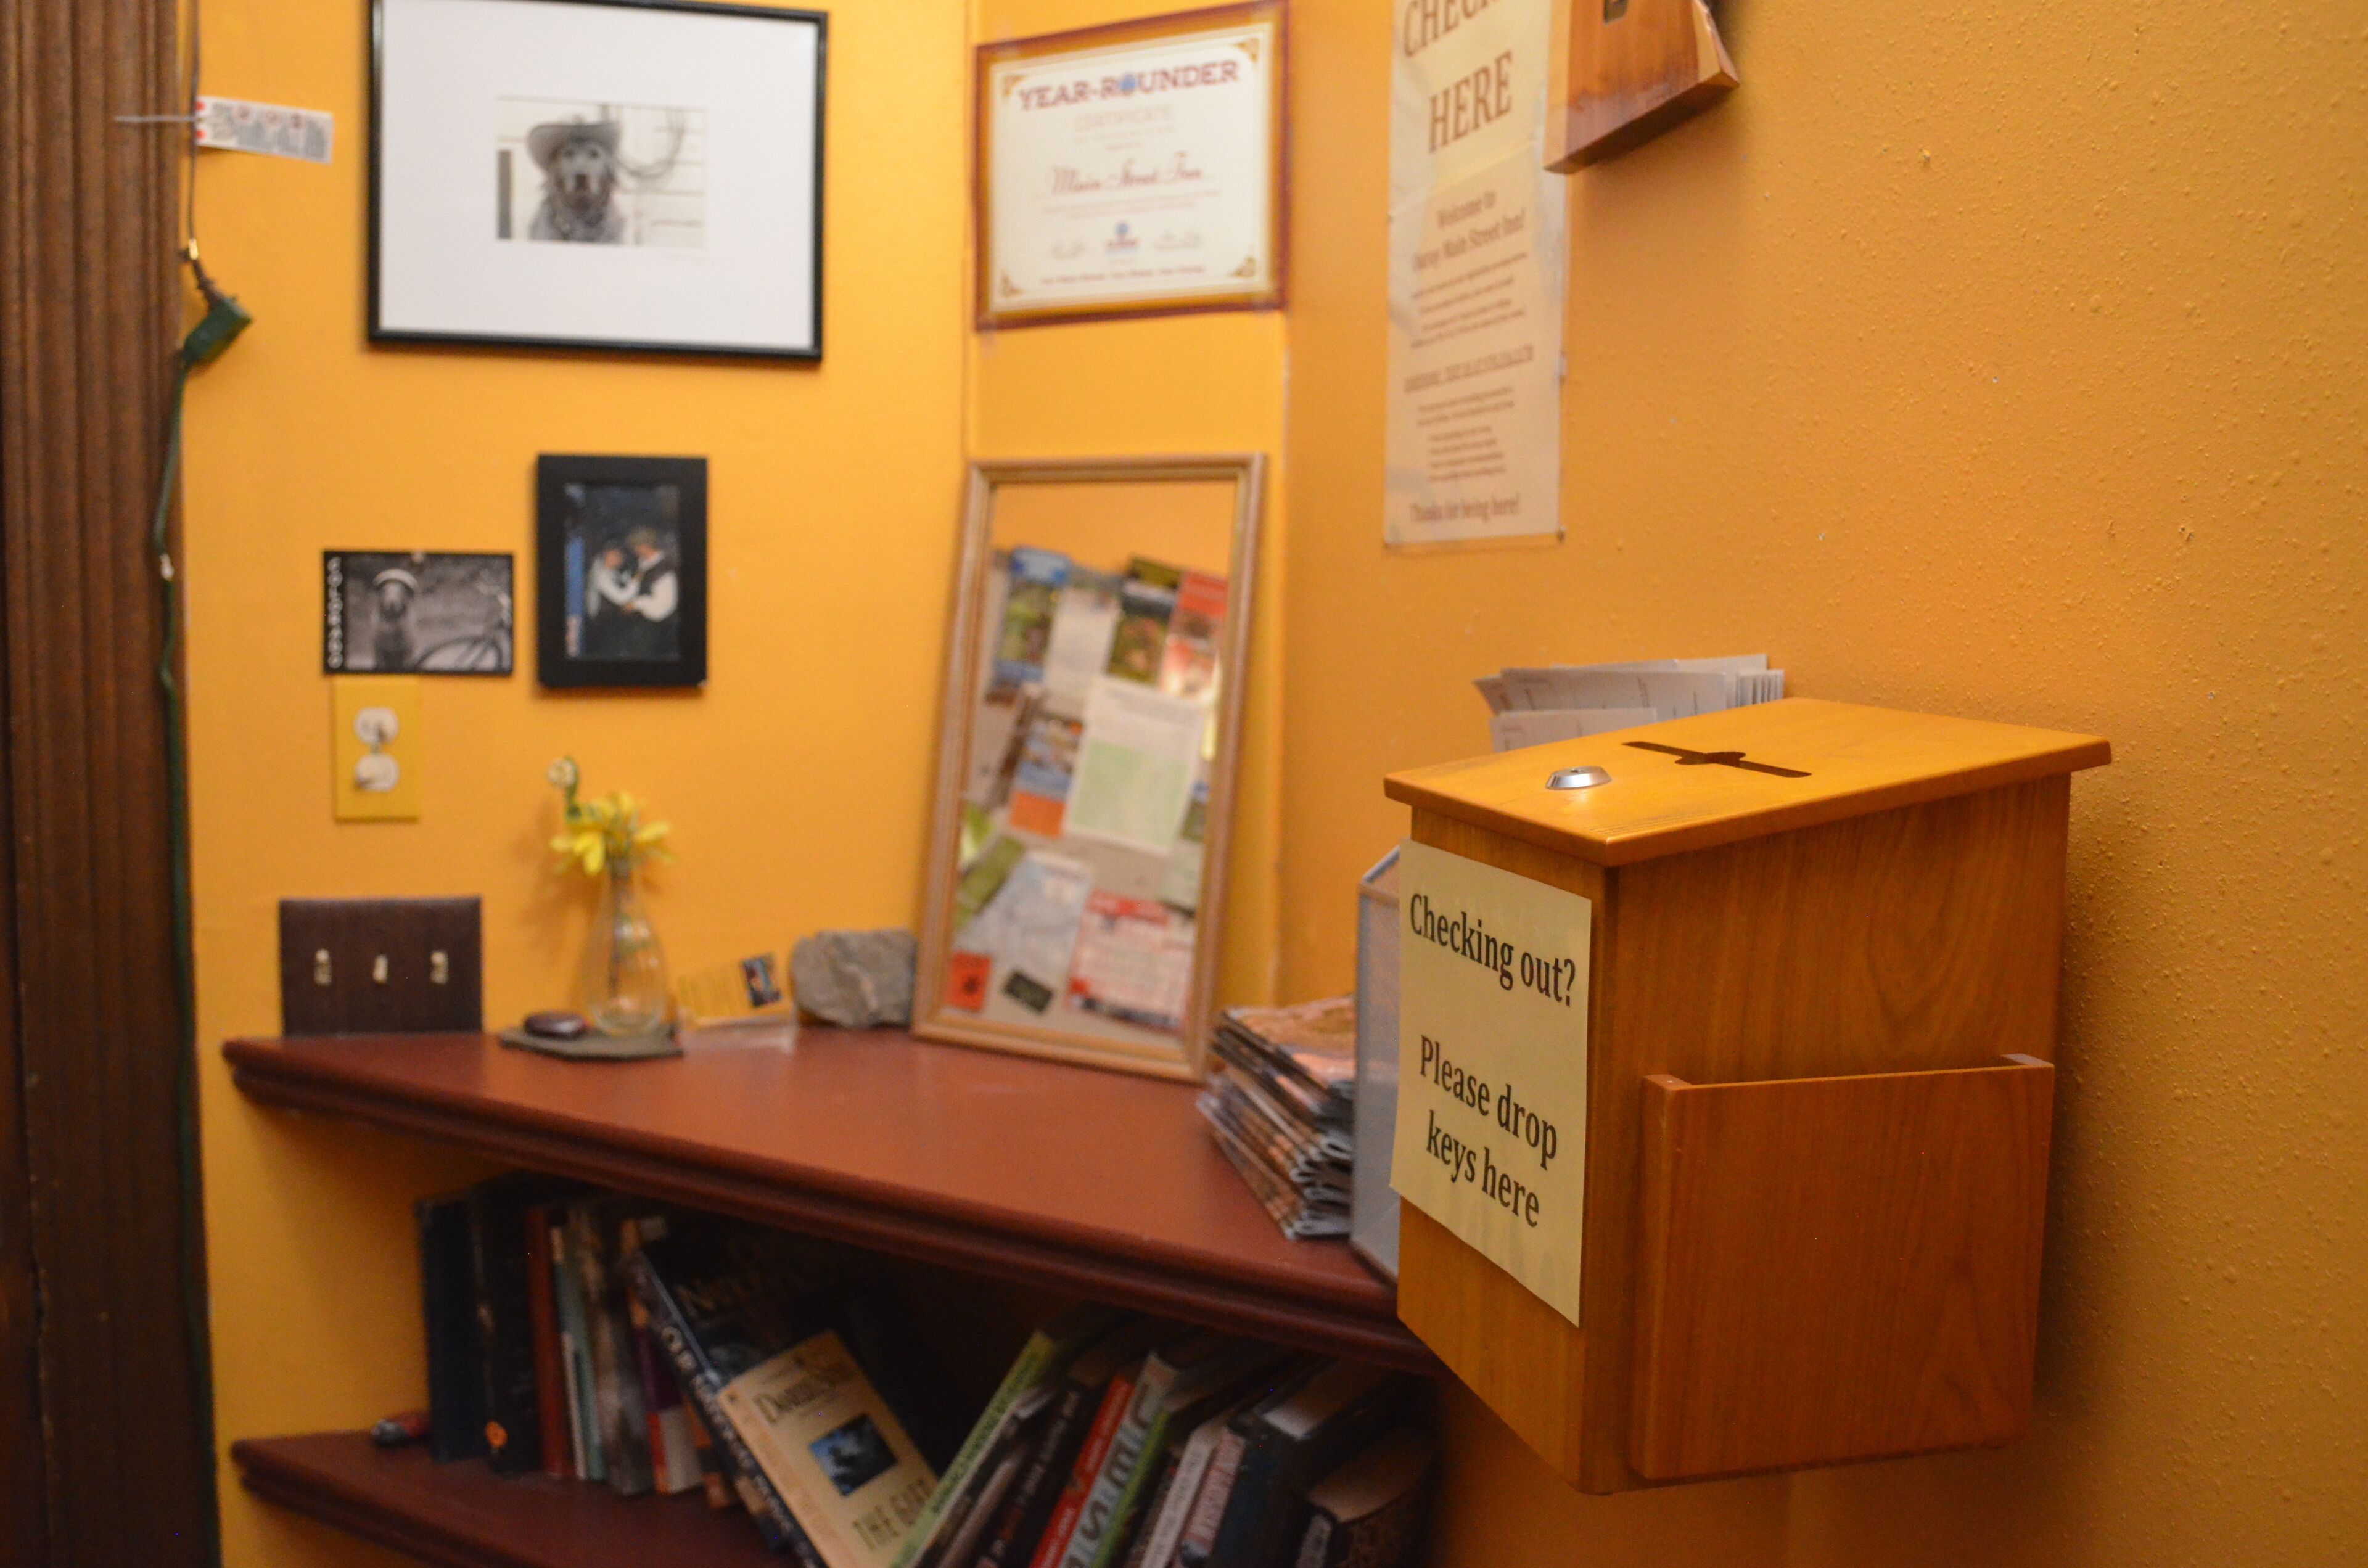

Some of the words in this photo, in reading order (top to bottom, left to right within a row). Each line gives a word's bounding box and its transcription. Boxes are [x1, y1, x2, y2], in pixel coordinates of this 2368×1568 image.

[1429, 49, 1513, 153] HERE
[1051, 165, 1102, 195] Main
[1410, 892, 1515, 990] Checking
[1521, 951, 1576, 1007] out?
[1420, 1035, 1490, 1117] Please
[1497, 1085, 1557, 1170] drop
[1426, 1110, 1476, 1183] keys
[1484, 1146, 1540, 1228] here
[851, 1504, 898, 1552] THE
